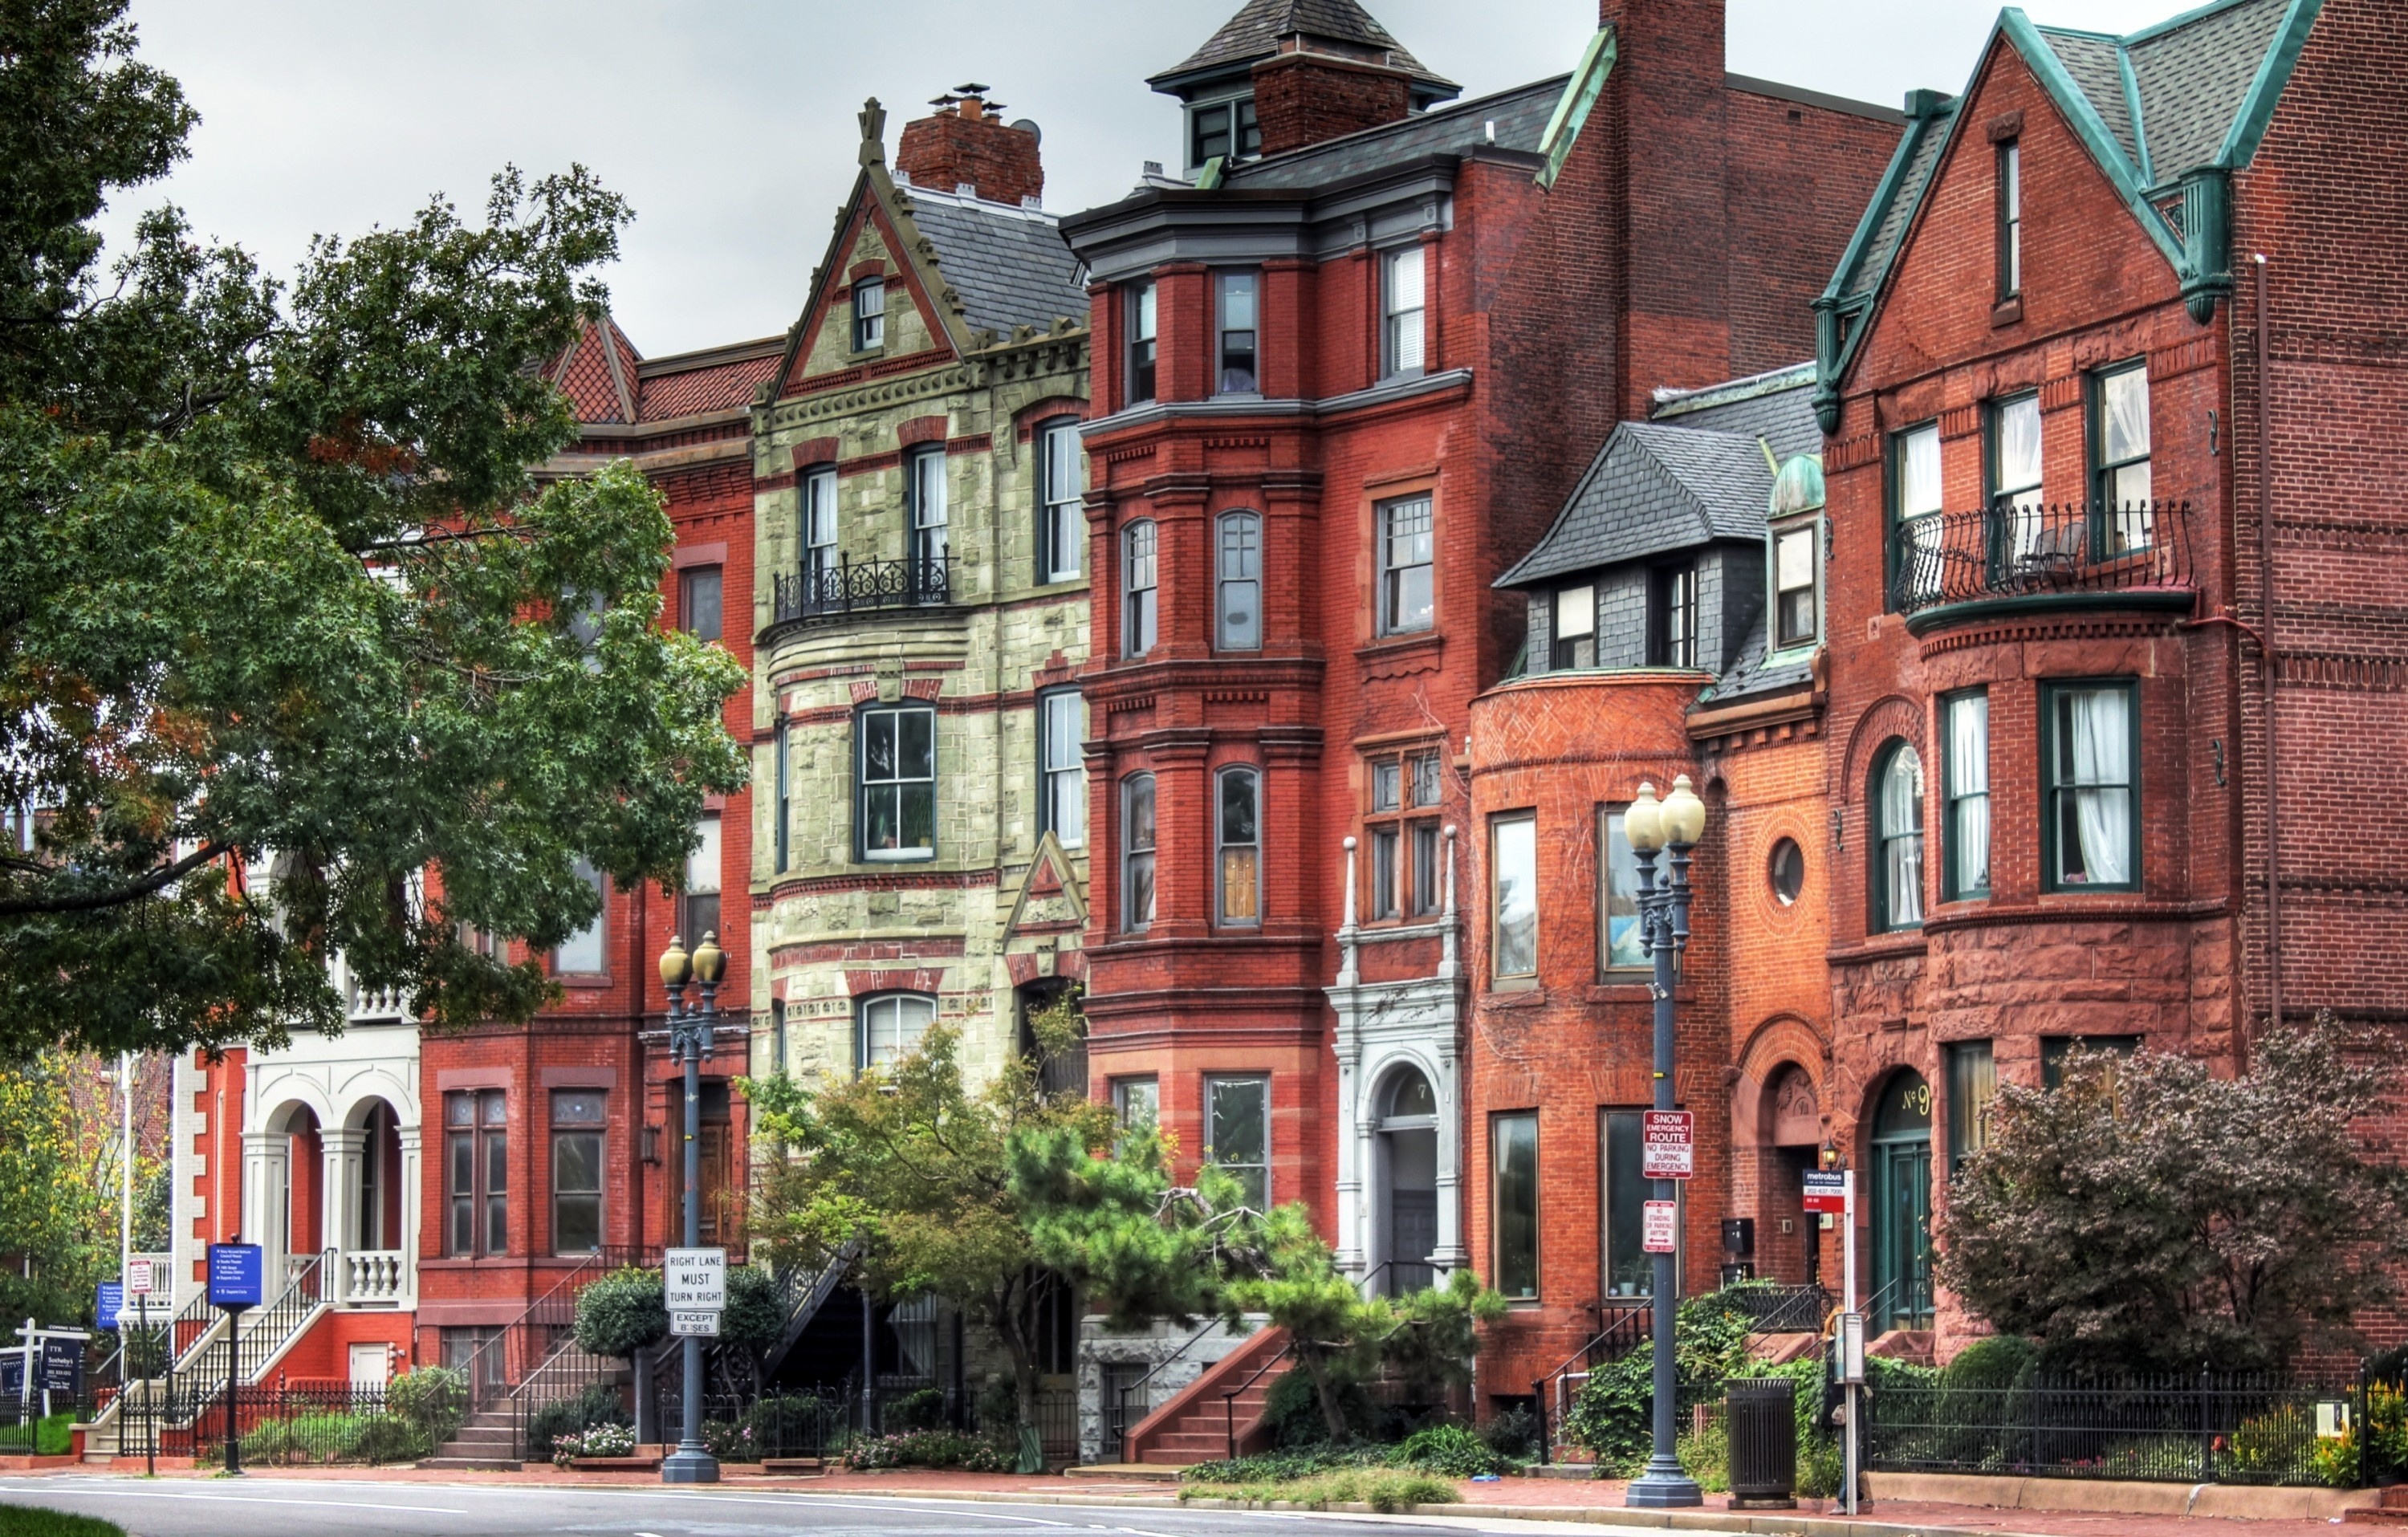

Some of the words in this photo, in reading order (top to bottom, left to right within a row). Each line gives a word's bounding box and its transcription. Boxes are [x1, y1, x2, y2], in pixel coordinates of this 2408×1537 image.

[1418, 1084, 1426, 1099] 7
[1918, 1084, 1930, 1116] 9
[1653, 1114, 1683, 1124] SNOW
[1646, 1124, 1690, 1132] EMERGENCY
[1649, 1132, 1686, 1143] ROUTE
[1646, 1144, 1657, 1152] NO
[1660, 1145, 1689, 1153] PARKING
[1655, 1153, 1681, 1161] DURING
[1646, 1162, 1689, 1170] EMERGENCY
[1807, 1173, 1841, 1181] metrobus
[670, 1257, 695, 1267] RIGHT
[699, 1257, 721, 1267] LANE
[681, 1274, 710, 1285] MUST
[670, 1292, 693, 1302] TURN
[697, 1291, 722, 1302] RIGHT
[677, 1314, 714, 1322] EXCEPT
